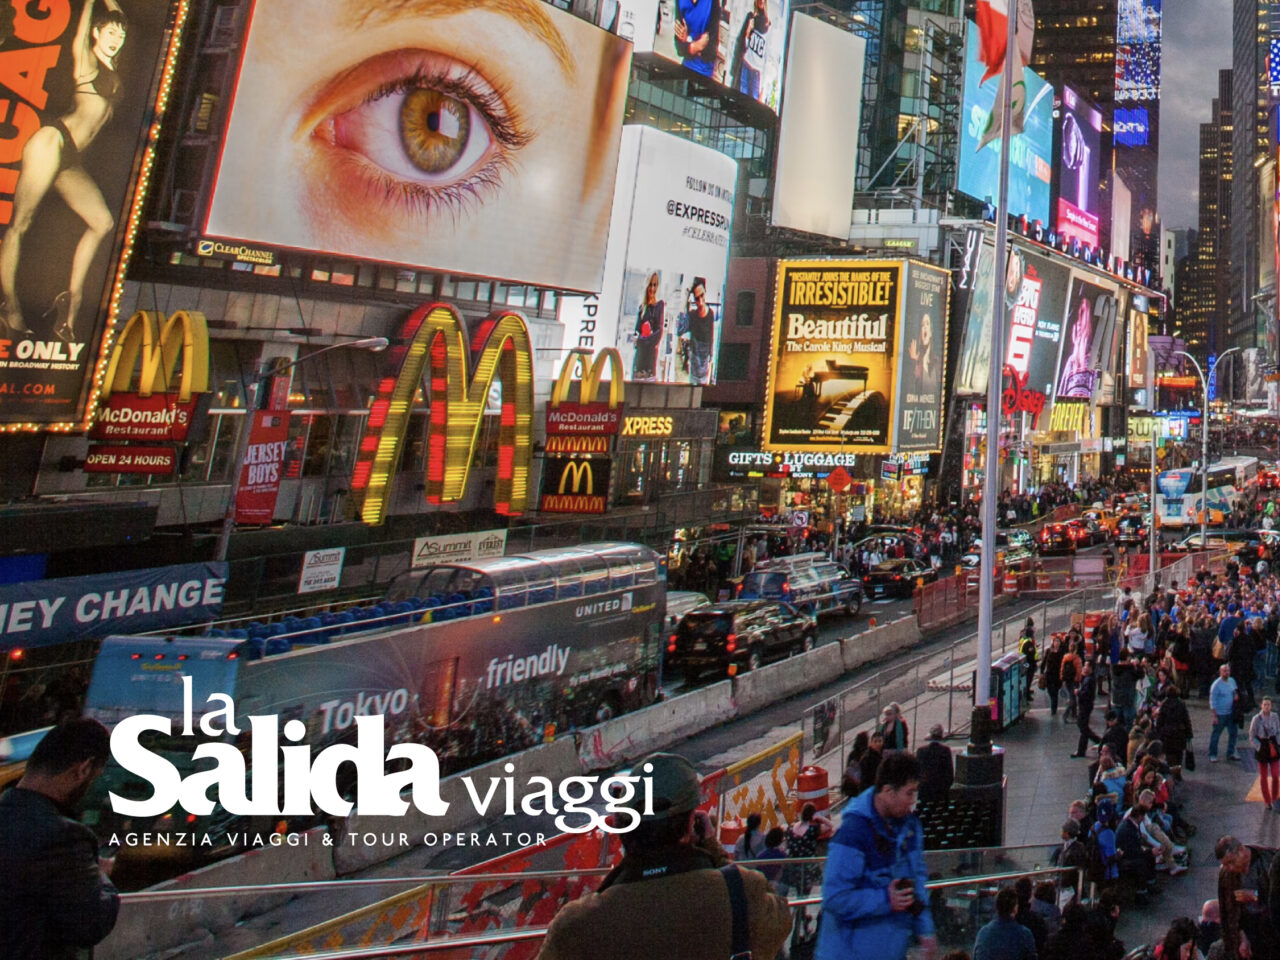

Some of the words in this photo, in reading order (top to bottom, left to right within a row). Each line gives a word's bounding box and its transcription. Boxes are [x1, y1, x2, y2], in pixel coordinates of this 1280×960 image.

[920, 292, 934, 307] LIVE
[787, 313, 889, 339] Beautiful
[16, 340, 85, 361] ONLY
[787, 341, 802, 352] The
[804, 341, 830, 352] Carole
[832, 342, 852, 354] King
[853, 341, 886, 352] Musical
[9, 361, 50, 369] BROADWAY
[99, 406, 188, 425] McDonald's
[549, 411, 617, 423] McDonald's
[1049, 402, 1085, 431] FOREVER
[105, 425, 169, 435] Restaurant
[622, 416, 673, 436] XPRESS
[87, 454, 116, 465] OPEN
[119, 454, 132, 465] 24
[134, 454, 171, 465] HOURS
[244, 442, 288, 465] JERSEY
[729, 452, 773, 465] GIFTS
[784, 453, 855, 467] LUGGAGE
[248, 463, 279, 485] BOYS
[428, 541, 471, 554] Summit
[314, 552, 341, 565] Summit
[76, 577, 226, 624] CHANGE
[576, 599, 620, 617] UNITED
[485, 645, 570, 690] friendly
[319, 686, 408, 734] Tokyo
